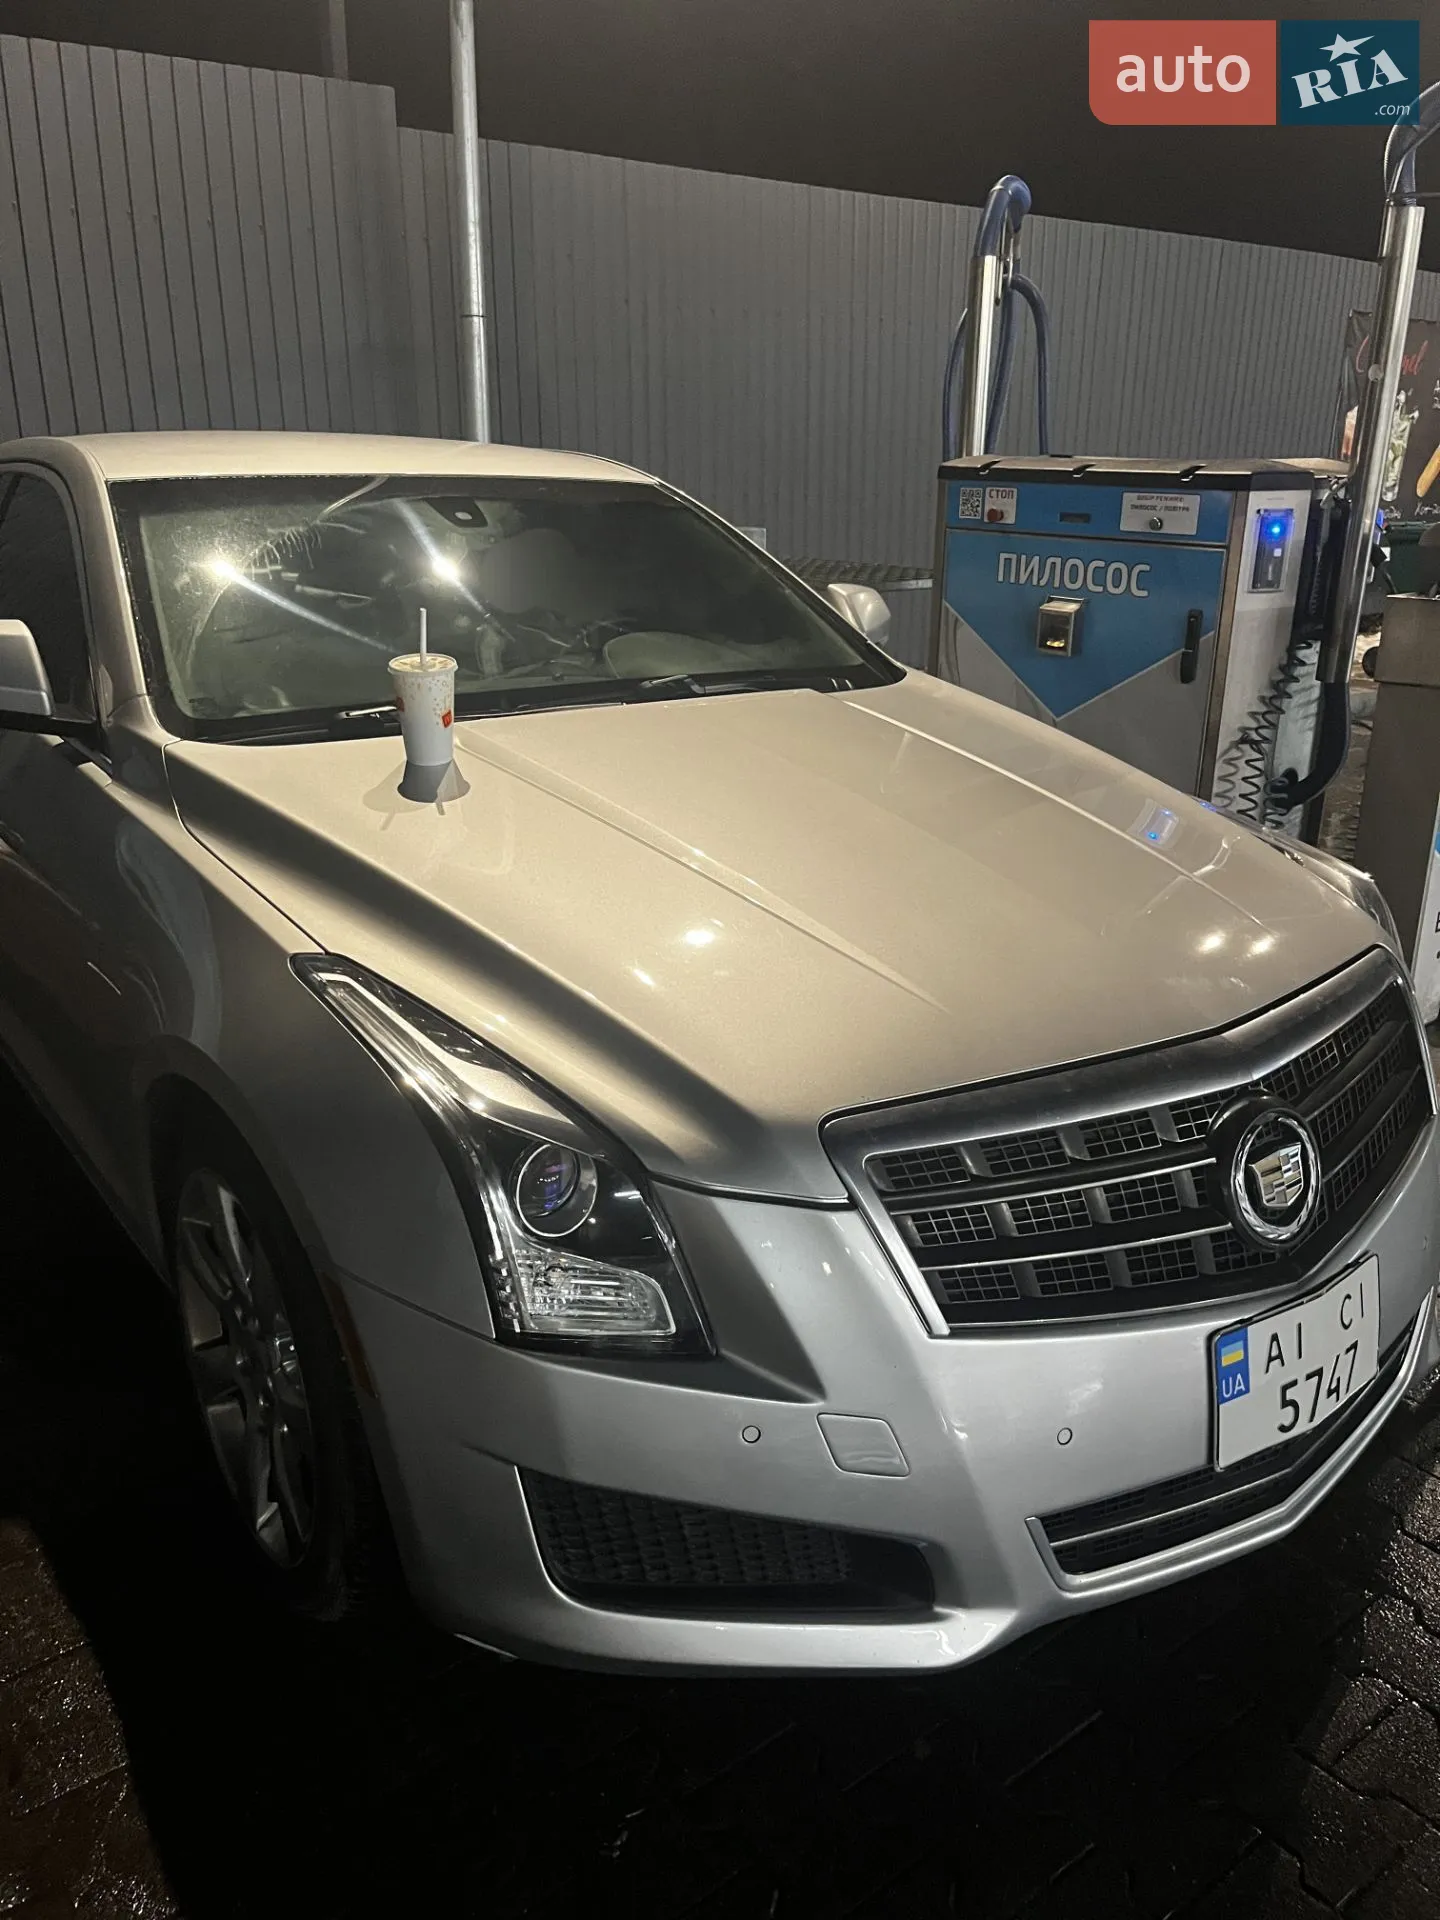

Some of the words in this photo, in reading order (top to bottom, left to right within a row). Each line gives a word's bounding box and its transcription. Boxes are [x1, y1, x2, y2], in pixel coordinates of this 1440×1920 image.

[989, 489, 1015, 499] СТОП
[997, 552, 1151, 598] ПИЛОСОС
[1222, 1373, 1246, 1398] UA
[1277, 1340, 1358, 1433] 5747
